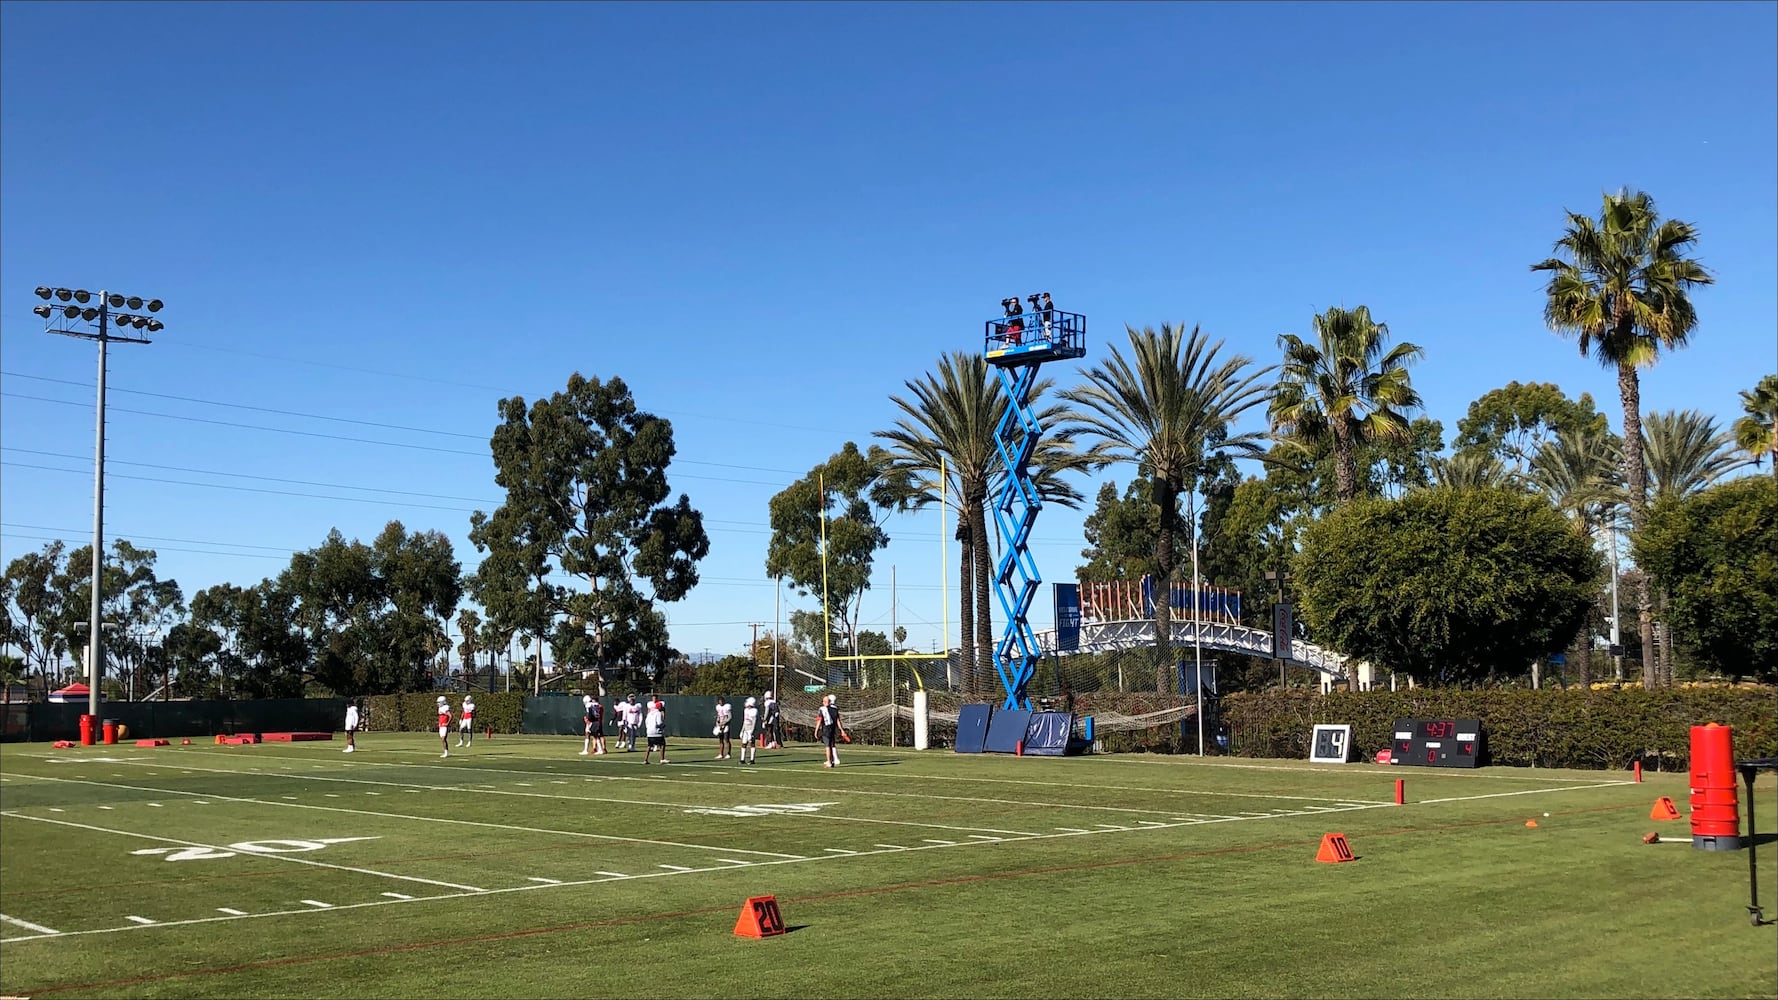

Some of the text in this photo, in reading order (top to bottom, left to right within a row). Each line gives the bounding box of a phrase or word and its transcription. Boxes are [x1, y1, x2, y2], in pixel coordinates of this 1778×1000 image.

[1426, 721, 1455, 738] 4:37
[1331, 732, 1344, 755] 4
[1402, 742, 1410, 753] 4
[1464, 744, 1472, 754] 4
[1427, 750, 1436, 763] 0
[1662, 797, 1677, 815] G
[129, 839, 328, 862] 20
[1330, 837, 1352, 859] 10
[753, 900, 785, 933] 20
